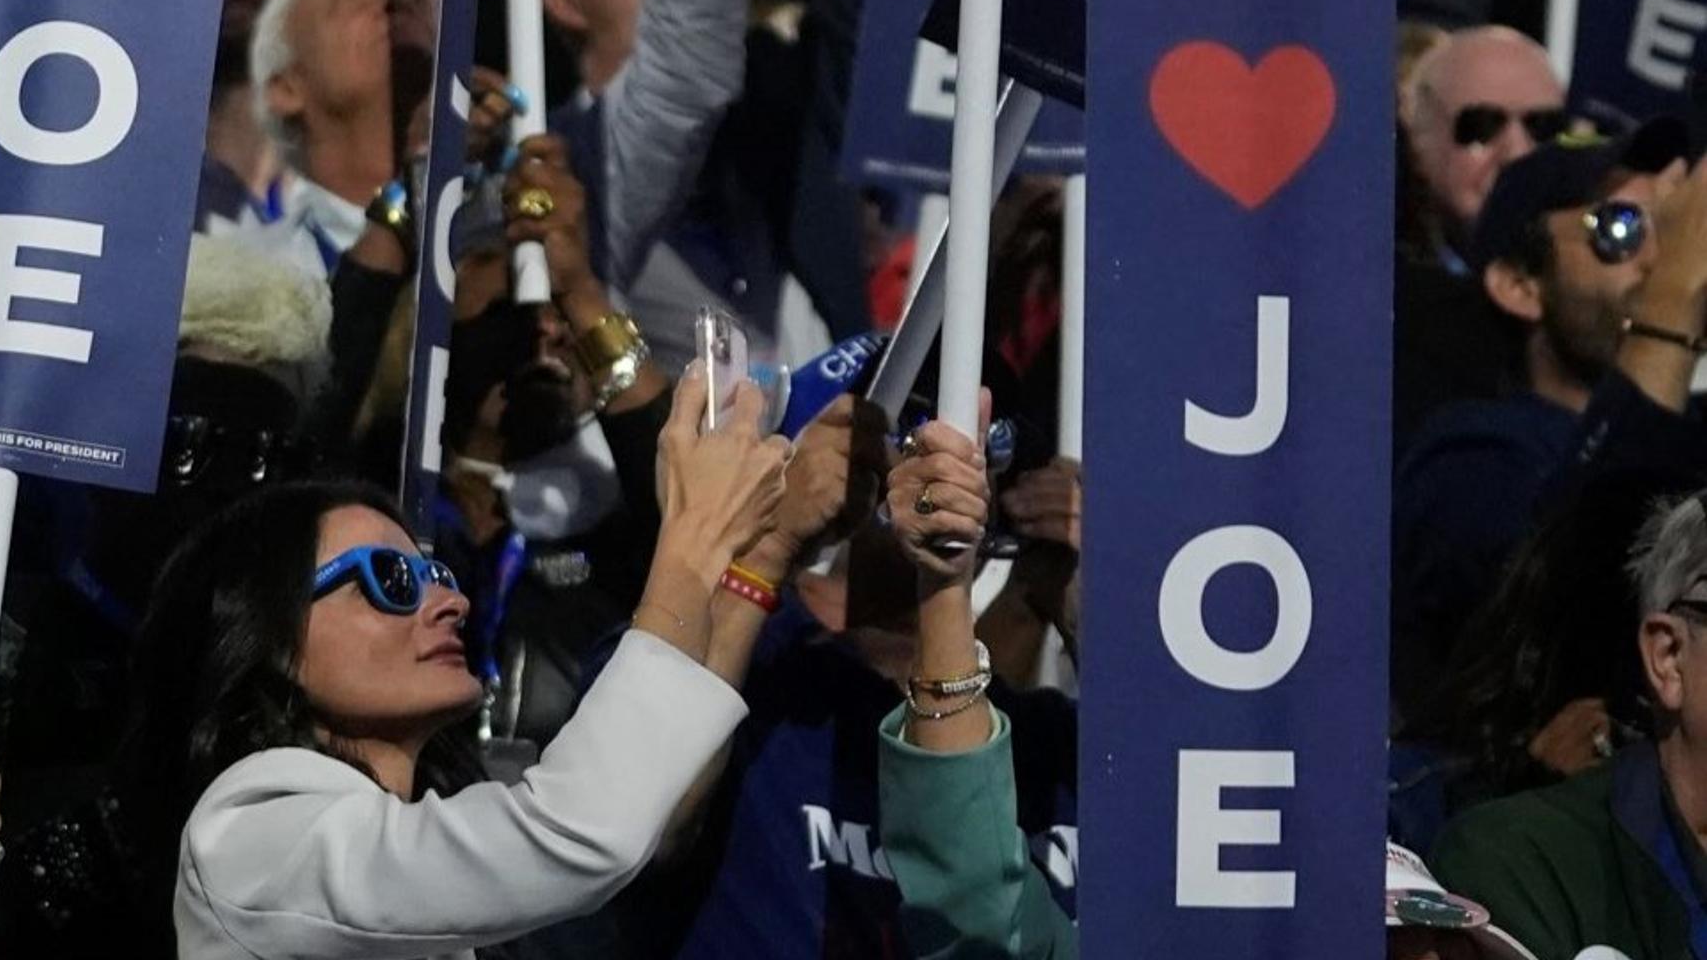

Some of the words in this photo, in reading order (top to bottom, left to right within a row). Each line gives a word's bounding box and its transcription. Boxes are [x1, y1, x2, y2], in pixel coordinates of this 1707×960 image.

[16, 435, 44, 450] FOR
[44, 440, 121, 464] PRESIDENT
[1159, 295, 1313, 908] JOE
